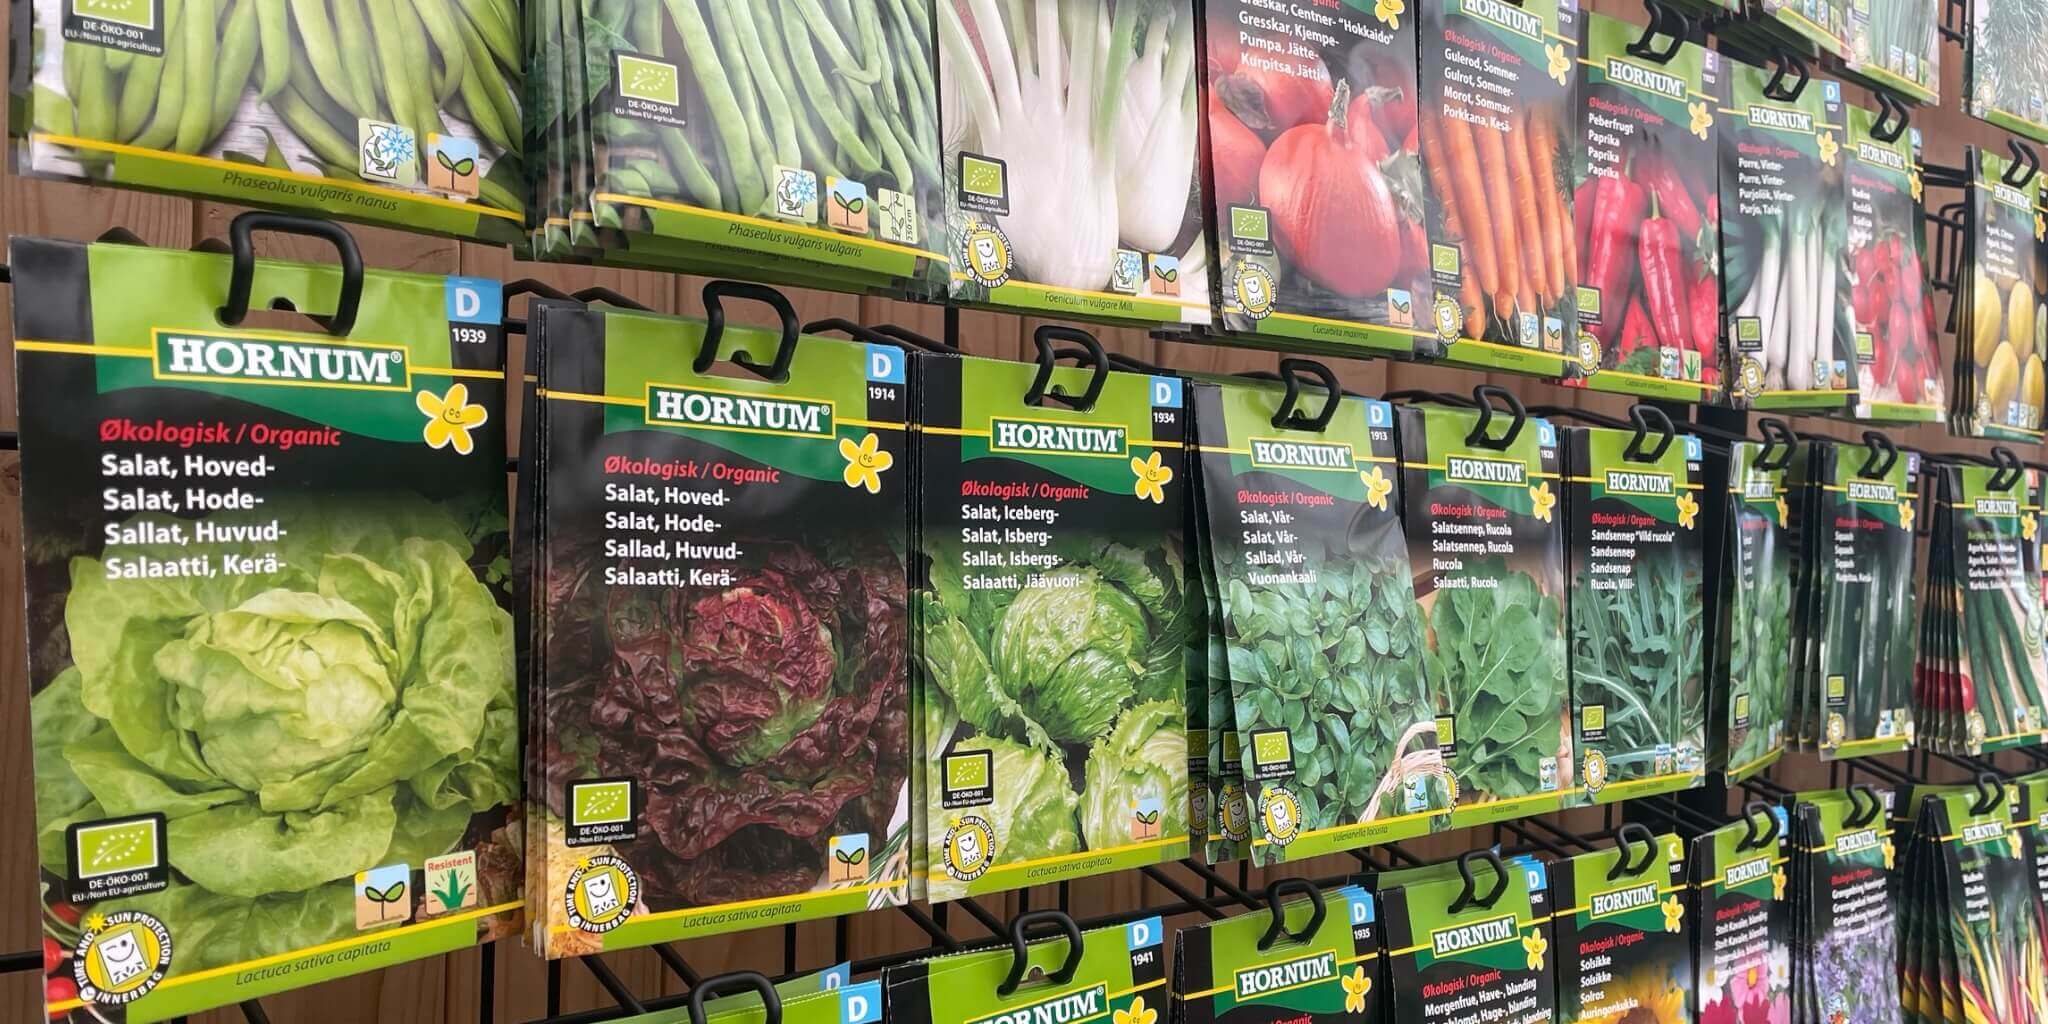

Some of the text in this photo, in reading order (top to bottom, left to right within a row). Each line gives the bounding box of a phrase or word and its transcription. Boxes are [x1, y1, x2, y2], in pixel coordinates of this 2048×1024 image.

[1291, 4, 1336, 26] Centner-
[83, 20, 144, 40] DE-ÖKO-001
[1239, 11, 1339, 47] Gresskar, Kjempe-
[1240, 32, 1319, 60] Pumpa, Jätte-
[1445, 30, 1520, 66] Økologisk Organic
[1241, 53, 1324, 81] Kurpitsa, Jätti-
[1445, 48, 1519, 81] Gulerod, Sommer-
[1444, 68, 1514, 96] Gulrot, Sommer-
[628, 99, 672, 116] DE-ÖKO-001
[1444, 86, 1513, 114] Morot, Sommar-
[1444, 104, 1488, 128] Porkkana,
[1588, 113, 1634, 135] Peberfrugt
[1588, 130, 1620, 146] Paprika
[1588, 146, 1620, 163] Paprika
[1588, 162, 1620, 180] Paprika
[222, 170, 398, 211] Phaseolus vulgaris nanus
[729, 222, 782, 243] Phaseolus
[783, 233, 822, 252] vulgaris
[824, 241, 863, 258] vulgaris
[455, 286, 480, 317] D
[1045, 292, 1118, 312] Foeniculum vulgare
[452, 327, 487, 344] 1939
[872, 352, 892, 378] D
[868, 386, 896, 402] 1914
[1155, 382, 1172, 404] D
[1153, 412, 1175, 424] 1934
[1370, 404, 1384, 424] D
[100, 418, 341, 450] Økologisk Organic
[1371, 430, 1388, 442] 1913
[1540, 427, 1549, 443] D
[1688, 441, 1696, 456] D
[101, 454, 276, 479] Salat, Hoved-
[604, 456, 780, 484] Økologisk Organic
[103, 488, 264, 512] Salat, Hode-
[605, 483, 730, 506] Salat, Hoved-
[962, 481, 1089, 502] Økologisk Organic
[1237, 490, 1334, 508] Økologisk Organic
[962, 504, 1060, 524] Salat, Iceberg-
[1241, 510, 1296, 525] Salat, Vår-
[1430, 503, 1508, 520] Økologisk Organic
[605, 511, 722, 534] Salat, Hode-
[1432, 521, 1512, 538] Salatsennep, Rucola
[104, 520, 287, 546] Sallat, Huvud-
[962, 527, 1053, 546] Salat, Isberg-
[1243, 531, 1298, 546] Salat, Vår-
[1592, 530, 1636, 544] Sandsennep
[604, 539, 744, 560] Sallad, Huvud-
[1432, 540, 1514, 554] Salatsennep, Rucola
[1591, 546, 1636, 560] Sandsennep
[105, 553, 287, 580] Salaatti, Kerä-
[962, 550, 1064, 569] Sallat, Isbergs-
[1246, 550, 1308, 566] Sallad, Vår-
[1433, 558, 1462, 570] Rucola
[604, 566, 737, 588] Salaatti, Kerä-
[1248, 572, 1317, 585] Vuonankaali
[1591, 562, 1631, 576] Sandsenap
[963, 574, 1084, 590] Salaatti, Jäävuori-
[1434, 576, 1498, 590] Salaatti, Rucola
[1591, 579, 1618, 590] Rucola,
[427, 855, 473, 872] Resistent
[1058, 857, 1112, 872] sativa capitata
[89, 872, 150, 890] DE-ÖKO-001
[108, 880, 166, 897] EU-agriculture
[1528, 870, 1540, 888] D
[683, 903, 802, 928] Lactuca sativa capitata
[1354, 902, 1366, 922] D
[1133, 924, 1149, 946] D
[1354, 928, 1370, 940] 1935
[1580, 936, 1615, 955] Økologisk
[73, 911, 172, 1004] TIME AND SUN PROTECTION INNERBAG
[236, 941, 392, 986] Lactuca sativa capitata
[1132, 952, 1154, 966] 1941
[1580, 955, 1612, 972] Solsikke
[1423, 969, 1503, 1000] Økologisk Organic
[1580, 972, 1612, 988] Solsikke
[1425, 992, 1479, 1018] Morgenfrue,
[1479, 987, 1506, 1002] Have-,
[1506, 978, 1537, 996] blanding
[1480, 1004, 1508, 1020] Hage-,
[1508, 996, 1537, 1014] blanding
[1580, 993, 1604, 1005] Solros
[848, 996, 868, 1022] D
[1580, 998, 1638, 1020] Auringonkukka
